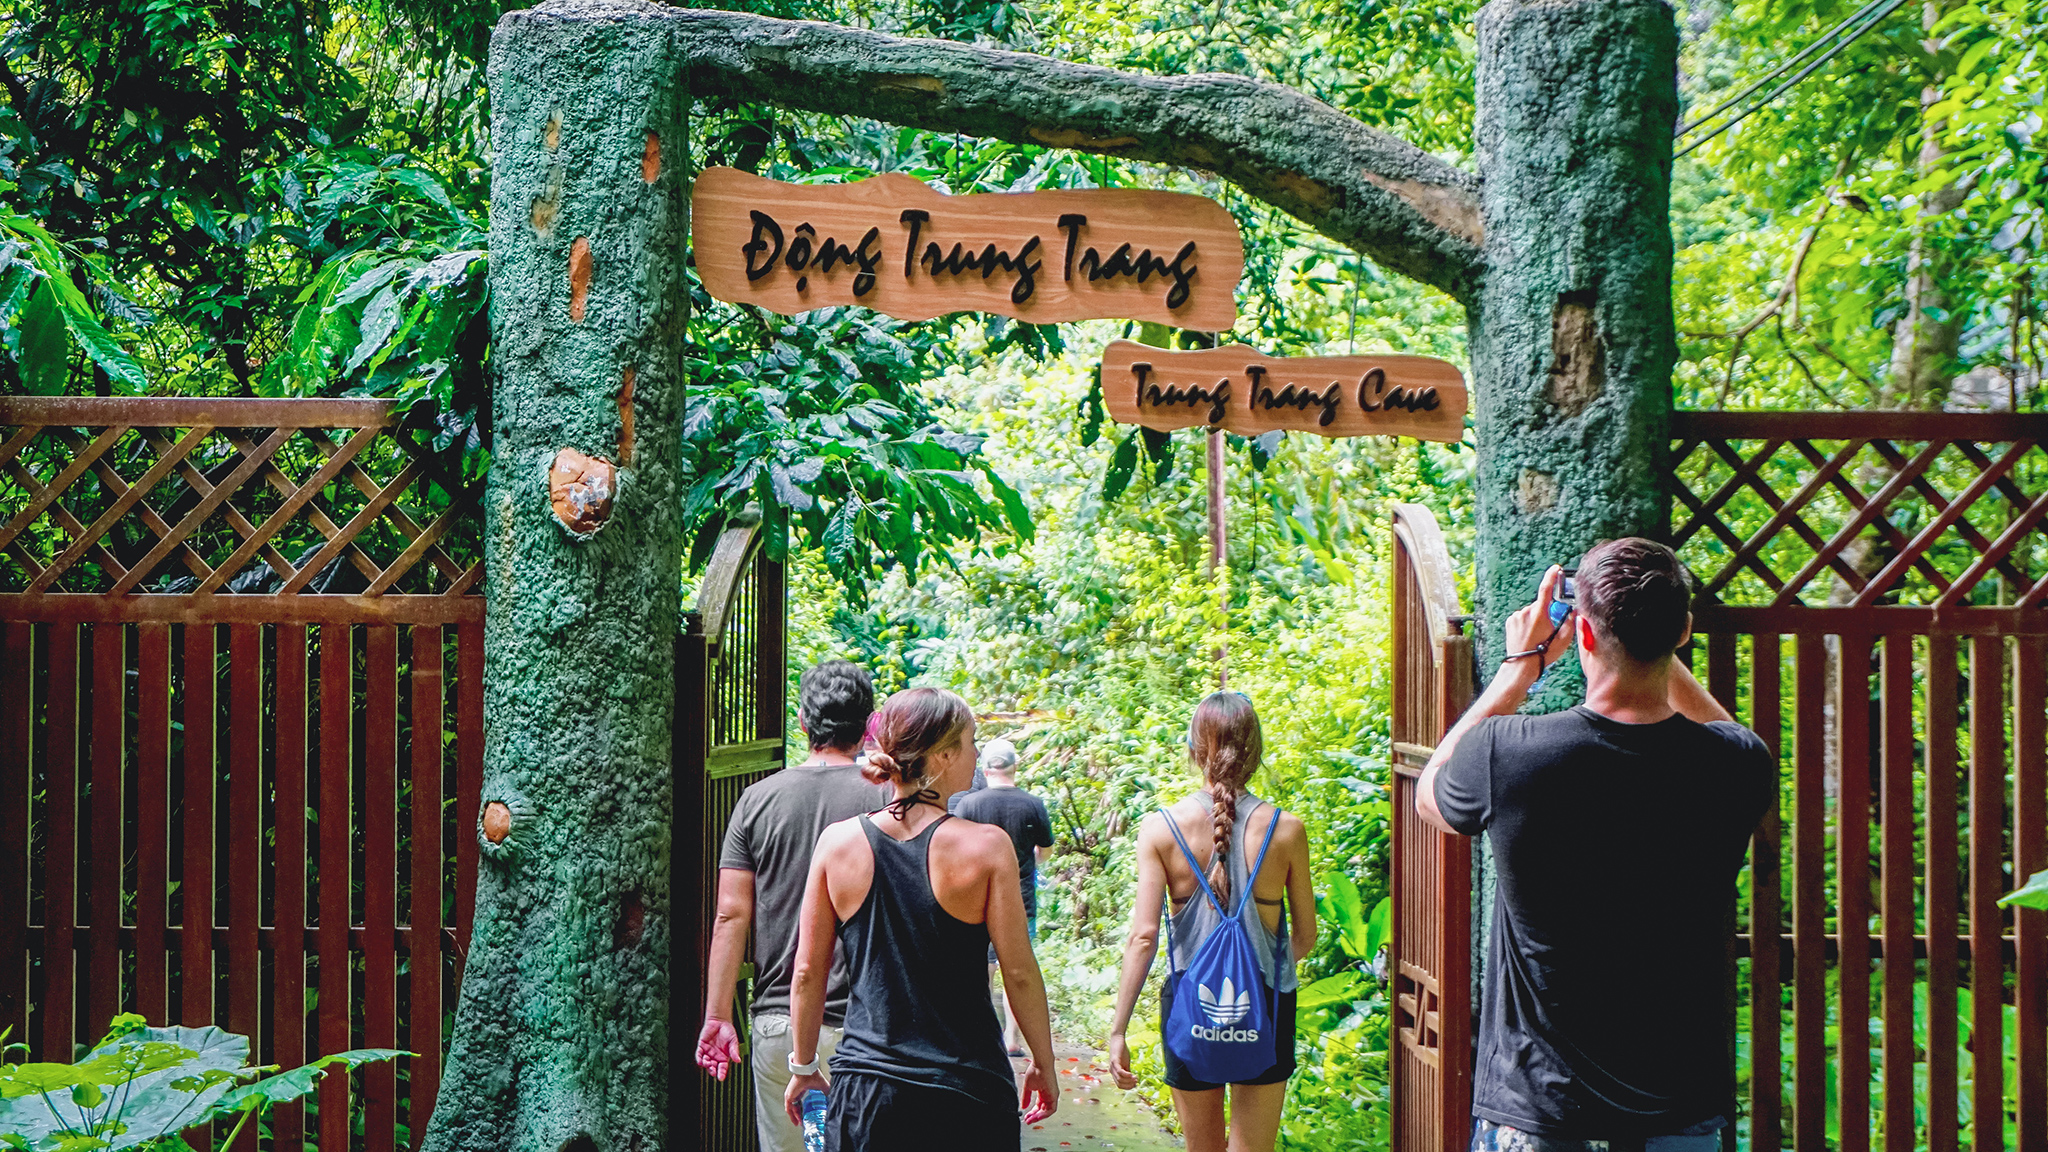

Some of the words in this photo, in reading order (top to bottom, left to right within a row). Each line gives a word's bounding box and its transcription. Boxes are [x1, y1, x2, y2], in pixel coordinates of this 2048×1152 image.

[743, 209, 882, 296] Động
[899, 209, 1042, 304] Trung
[1057, 213, 1198, 309] Trang
[1131, 362, 1231, 424] Trung
[1245, 364, 1340, 427] Trang
[1358, 367, 1440, 412] Cave
[1191, 1024, 1258, 1042] adidas
